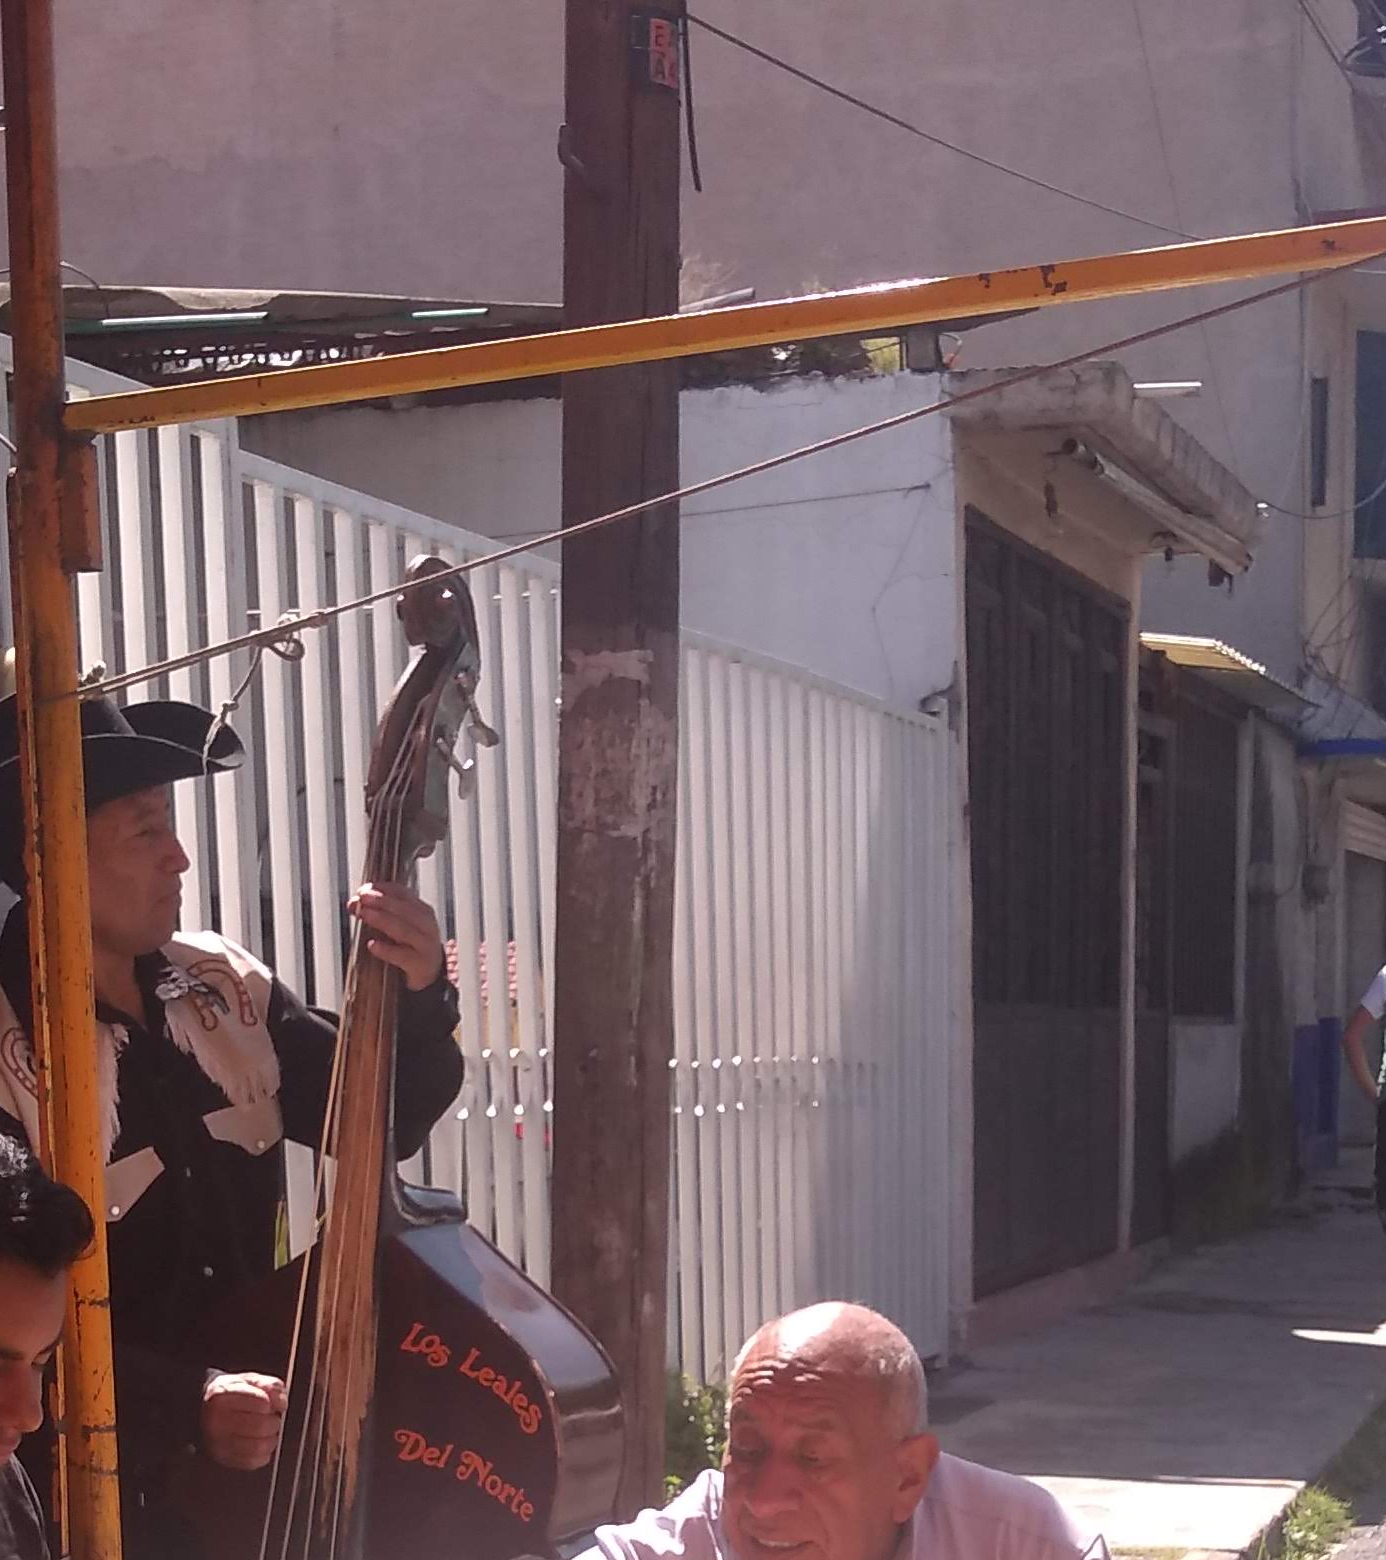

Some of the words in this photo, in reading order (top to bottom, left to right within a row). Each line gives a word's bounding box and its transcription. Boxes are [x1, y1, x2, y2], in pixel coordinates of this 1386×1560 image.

[400, 1322, 451, 1367] Los
[460, 1347, 542, 1434] Leales
[394, 1429, 454, 1469] Del
[456, 1450, 534, 1523] Norte
